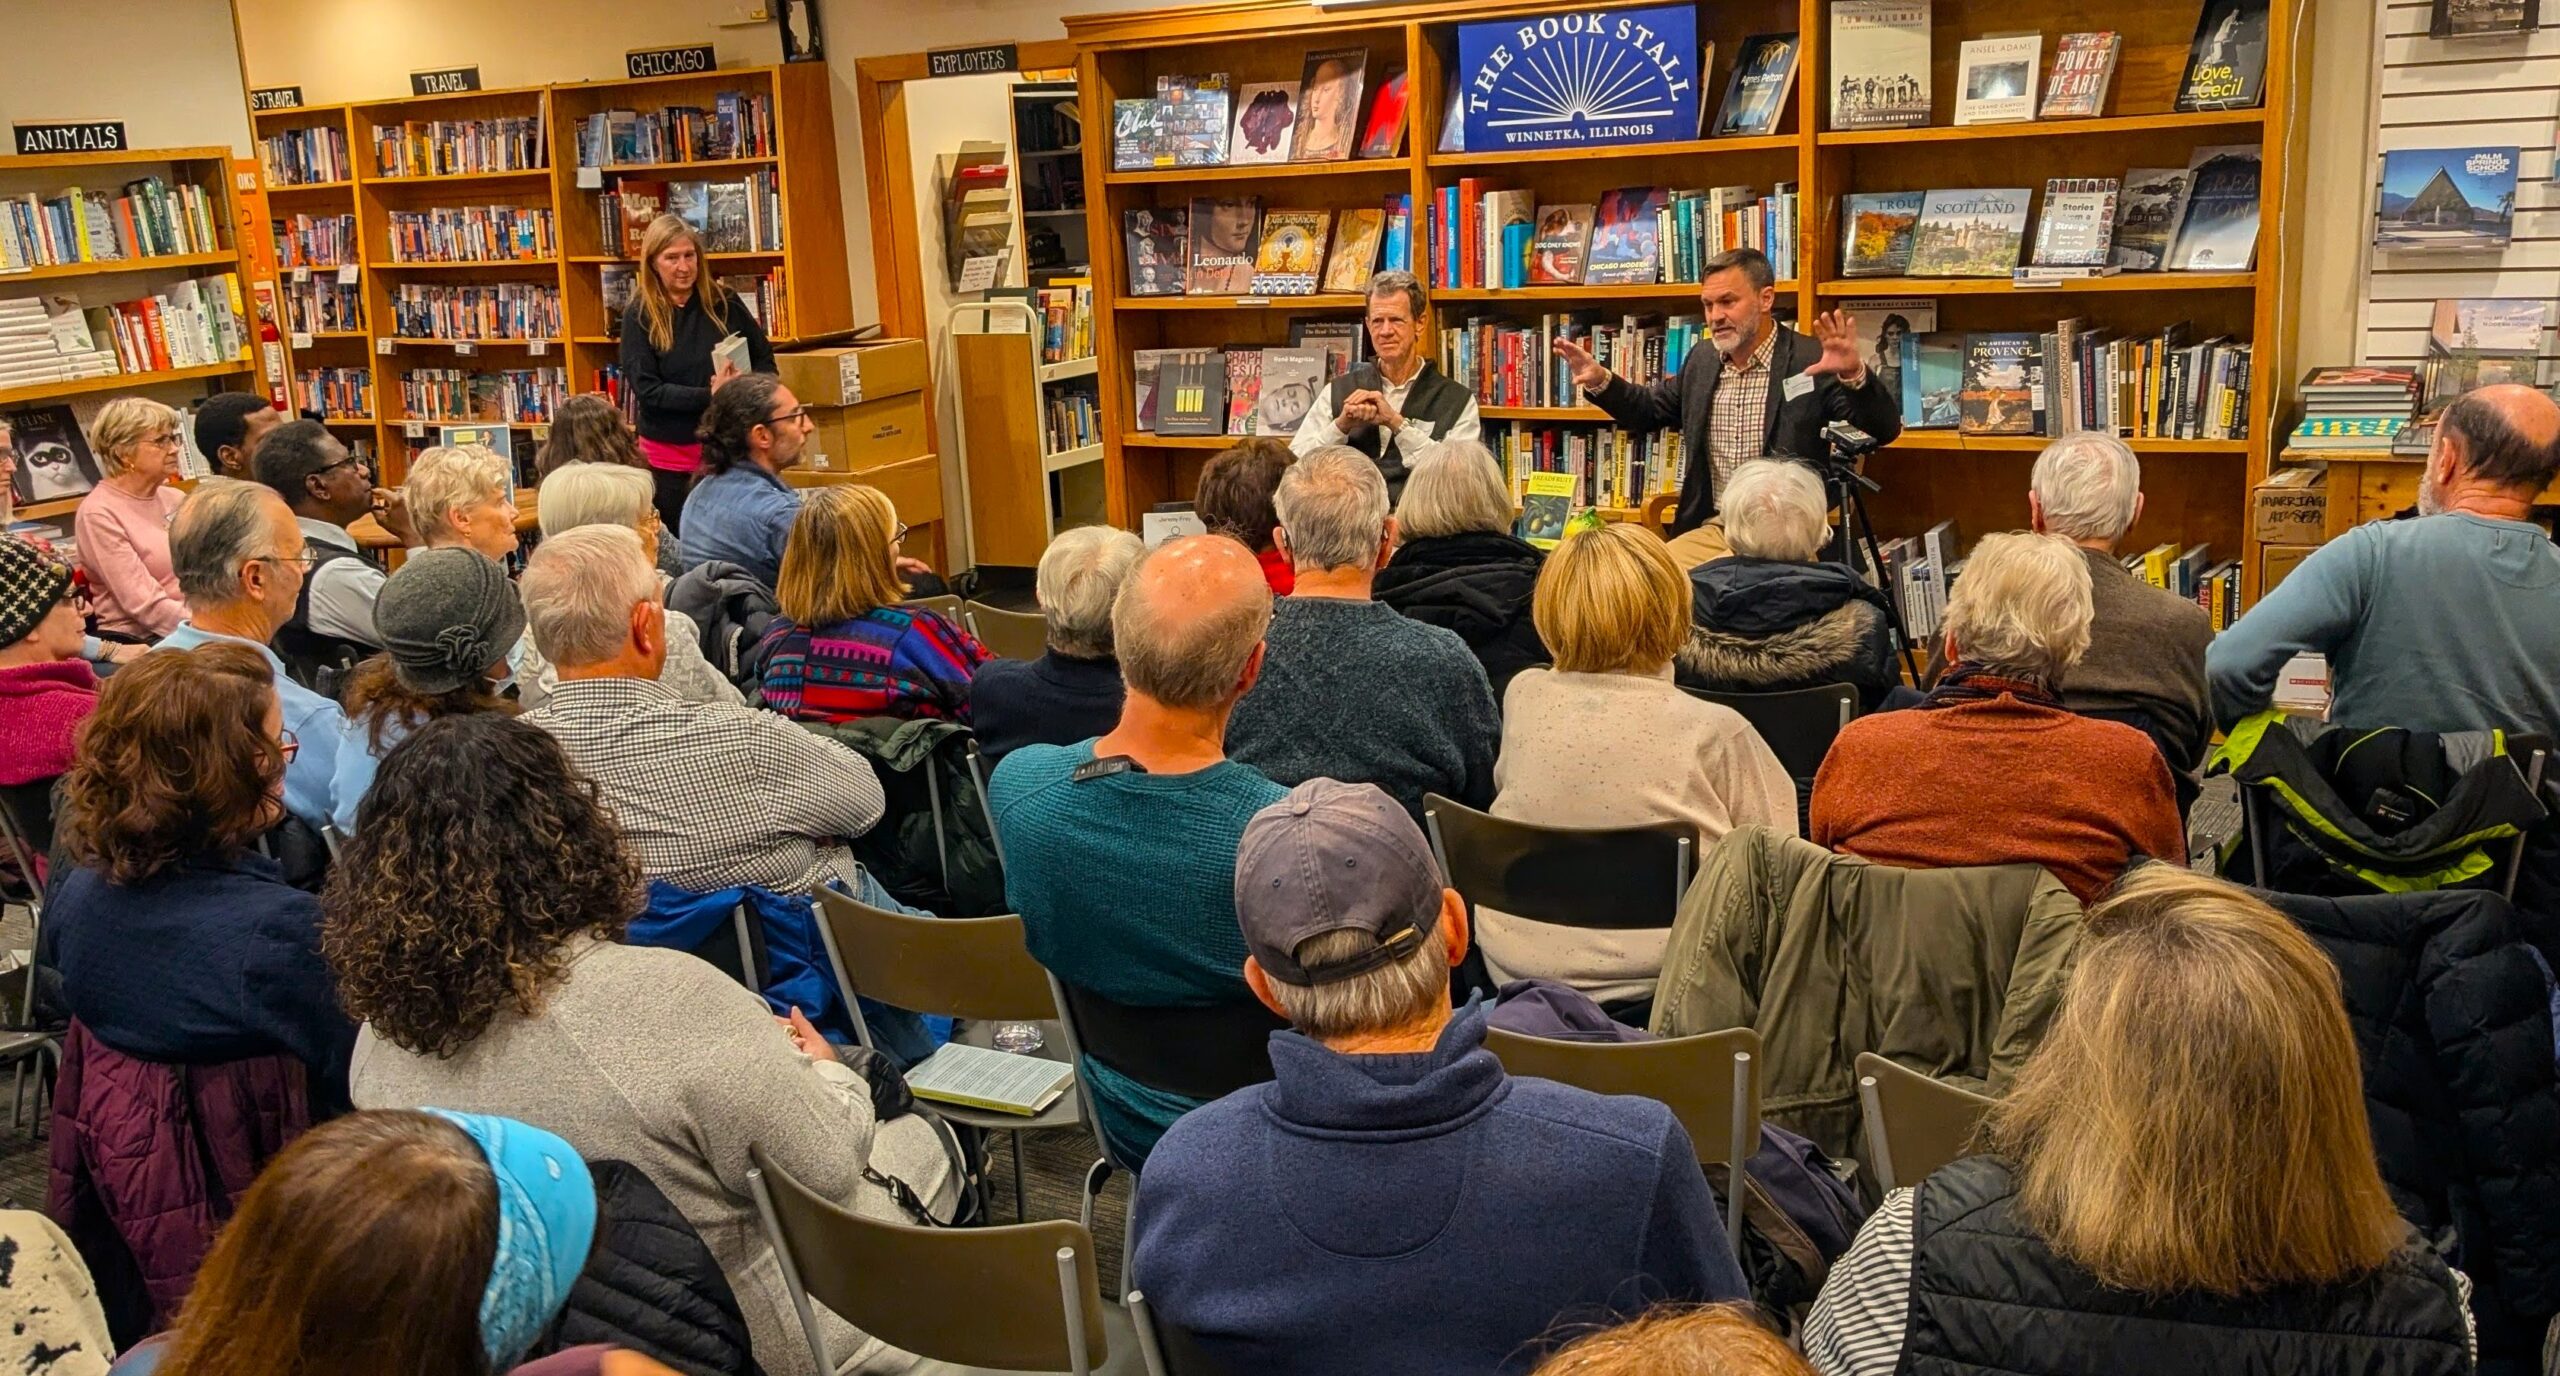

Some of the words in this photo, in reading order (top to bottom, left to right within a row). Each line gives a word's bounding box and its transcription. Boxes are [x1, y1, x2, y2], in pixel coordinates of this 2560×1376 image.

[1870, 12, 1922, 22] PALUMBO
[1969, 45, 1995, 54] ANSEL
[2001, 42, 2032, 52] ADAMS
[630, 50, 705, 76] CHICAGO
[932, 50, 1006, 74] EMPLOYEES
[1469, 44, 1514, 115] THE
[1516, 13, 1607, 50] BOOK
[1616, 18, 1689, 102] STALL
[2056, 51, 2106, 71] POWER
[1740, 75, 1760, 87] Agnes
[1761, 73, 1784, 83] Pelton
[2192, 64, 2233, 81] Love,
[422, 73, 468, 94] TRAVEL
[2048, 75, 2068, 96] OF
[2069, 74, 2100, 94] ART
[2198, 77, 2244, 98] Cecil
[24, 125, 118, 151] ANIMALS
[1505, 128, 1585, 144] WINNETKA,
[1589, 124, 1654, 138] ILLINOIS
[2465, 158, 2511, 166] SPRINGS
[2466, 164, 2509, 172] SCHOOL
[1877, 200, 1917, 210] TROU
[1934, 202, 2016, 214] SCOTLAND
[2062, 203, 2094, 211] Stories
[1193, 252, 1254, 266] Leonardo
[1590, 263, 1618, 271] CHICAGO
[148, 310, 162, 344] BIRDS
[160, 298, 172, 330] SIBLEY
[166, 332, 178, 357] BIRDS
[1973, 346, 2034, 357] PROVENCE
[2060, 344, 2070, 400] MONTGOMERY
[2171, 355, 2179, 378] FLASH
[2224, 392, 2233, 410] Bluff
[1676, 439, 1686, 480] MONDRIAN
[2214, 602, 2222, 629] NAKED
